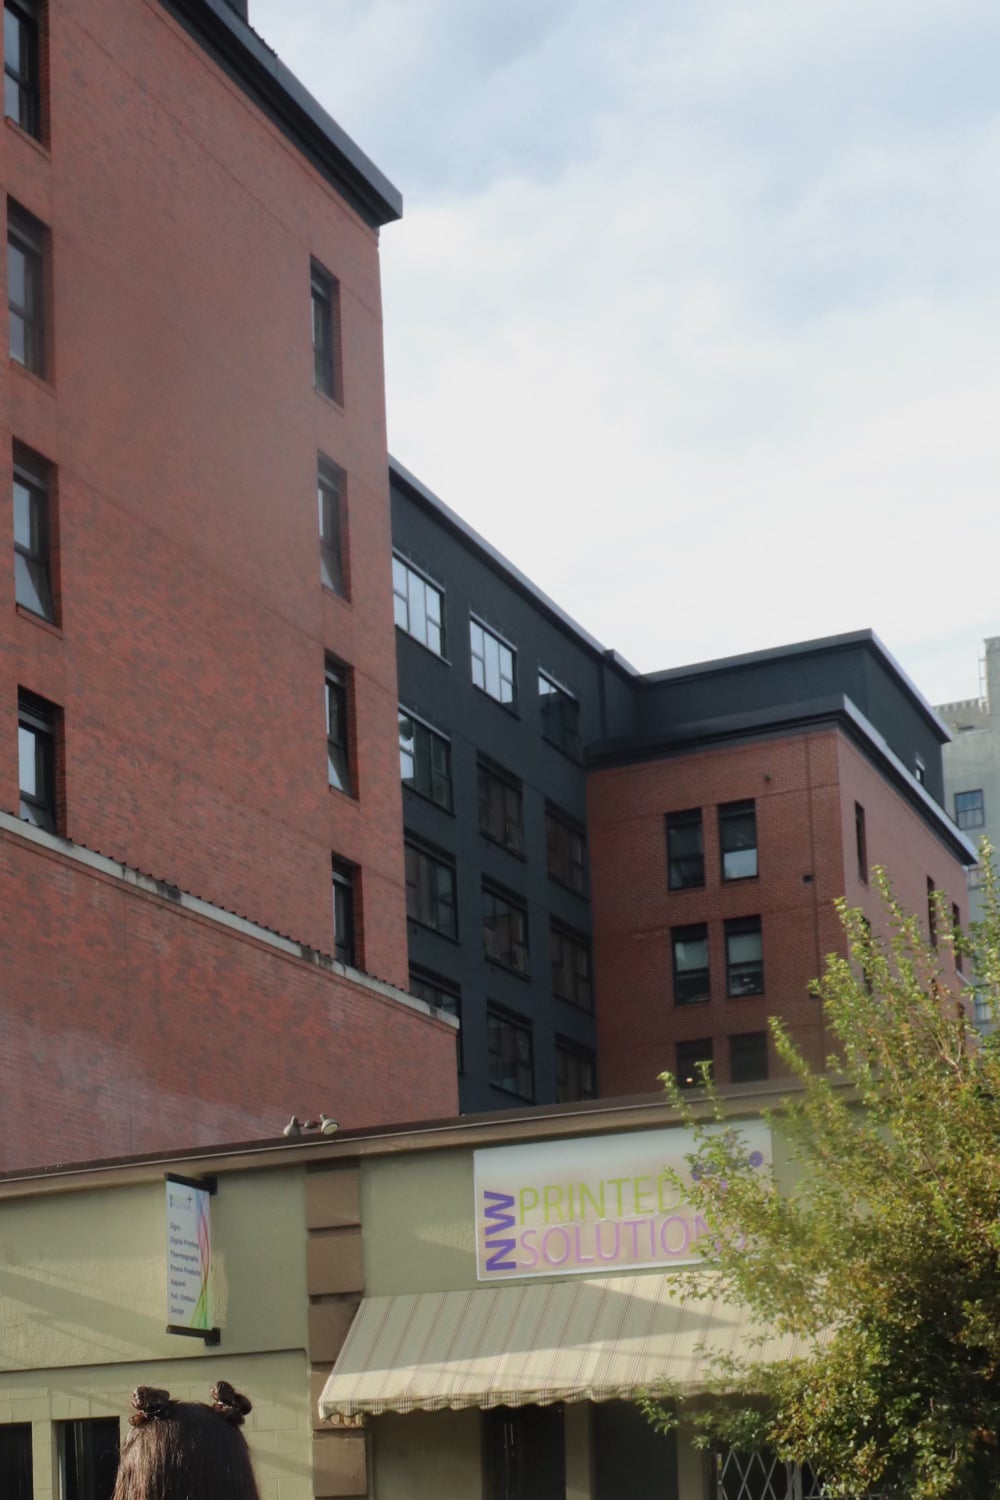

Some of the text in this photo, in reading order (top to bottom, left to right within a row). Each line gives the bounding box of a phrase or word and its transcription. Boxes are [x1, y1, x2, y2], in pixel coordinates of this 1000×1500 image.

[519, 1174, 684, 1225] PRINTED
[483, 1190, 517, 1272] NW
[169, 1236, 200, 1250] Digital Printing
[520, 1214, 746, 1268] SOLUTION
[170, 1250, 199, 1264] Thermography
[170, 1265, 201, 1277] Promo Products
[170, 1278, 186, 1288] Apparel
[170, 1306, 185, 1316] Design
